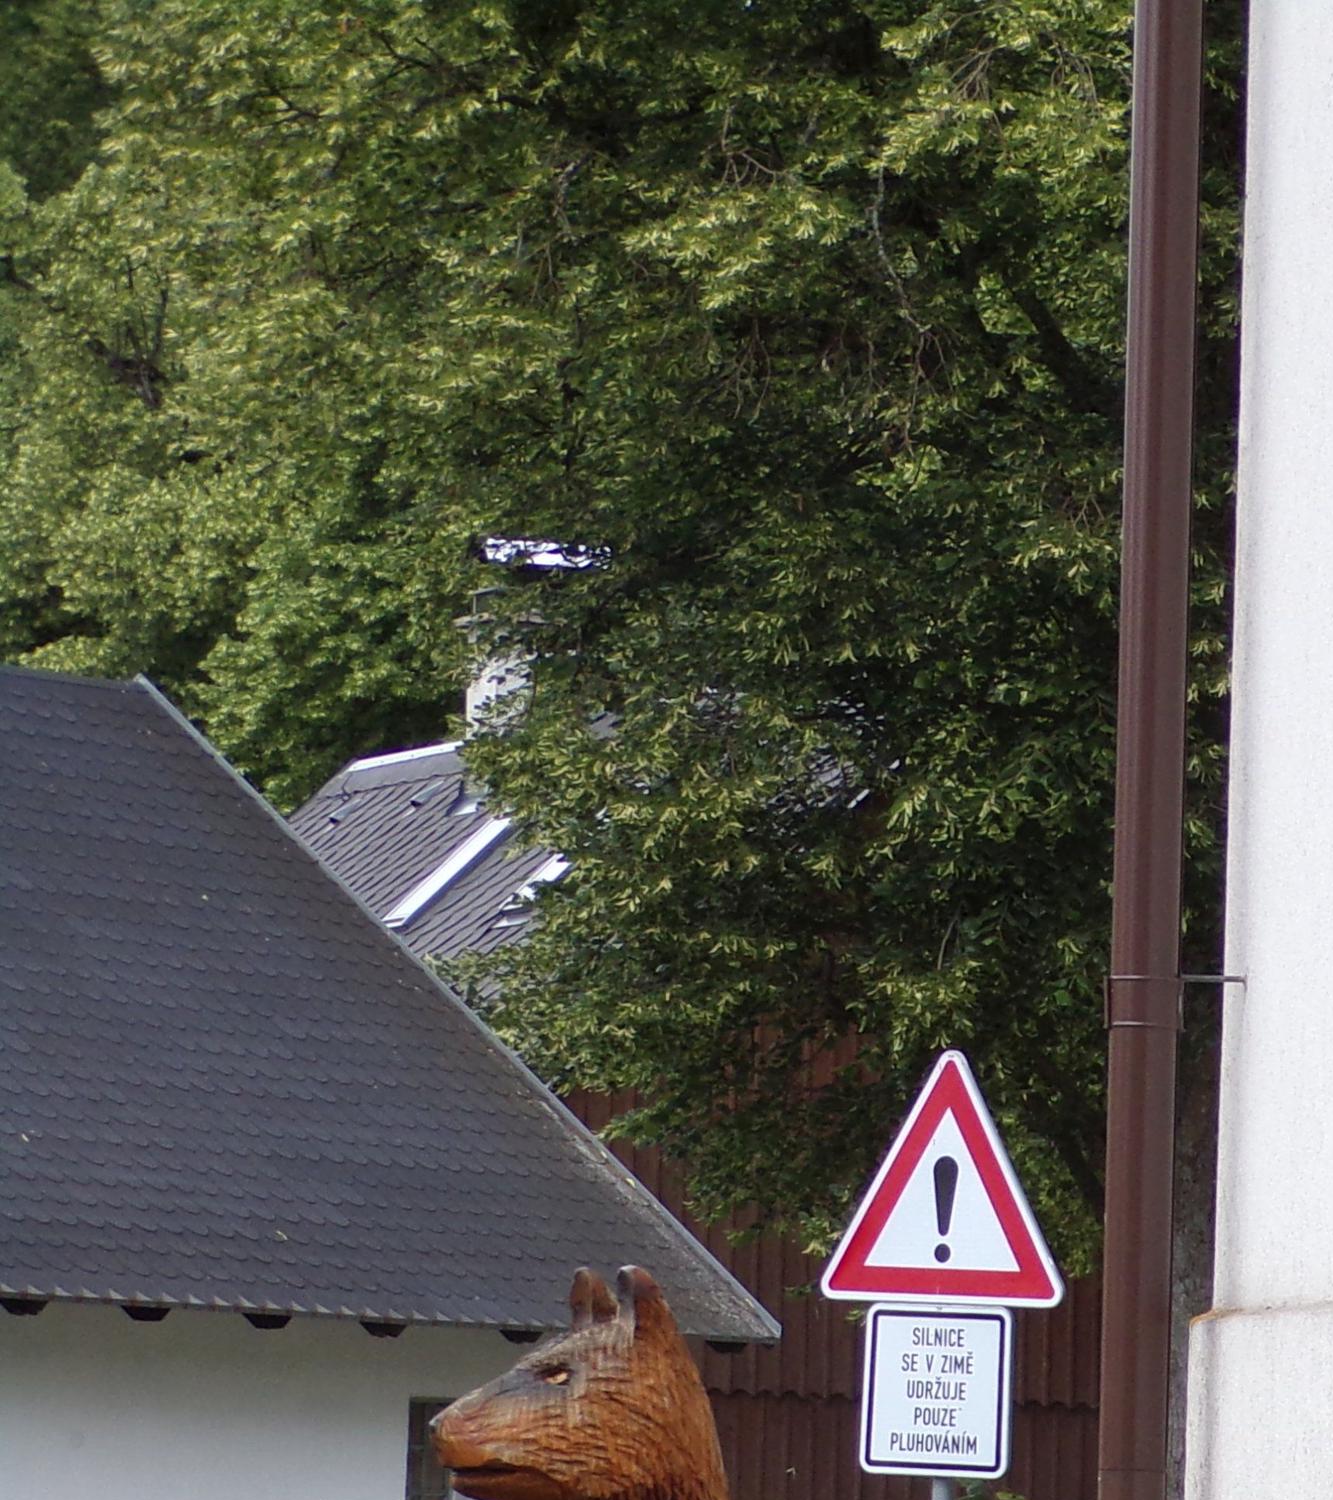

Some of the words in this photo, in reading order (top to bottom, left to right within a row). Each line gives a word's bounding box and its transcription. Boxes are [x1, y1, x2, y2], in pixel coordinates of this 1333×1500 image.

[912, 1327, 965, 1347] SILNICE
[901, 1353, 918, 1372] SE
[926, 1354, 934, 1373] V
[941, 1351, 973, 1374] ZIMĚ
[907, 1376, 967, 1401] UDRŽUJE
[914, 1407, 957, 1427] POUZE
[890, 1430, 977, 1455] PLUHOVÁNÍM
